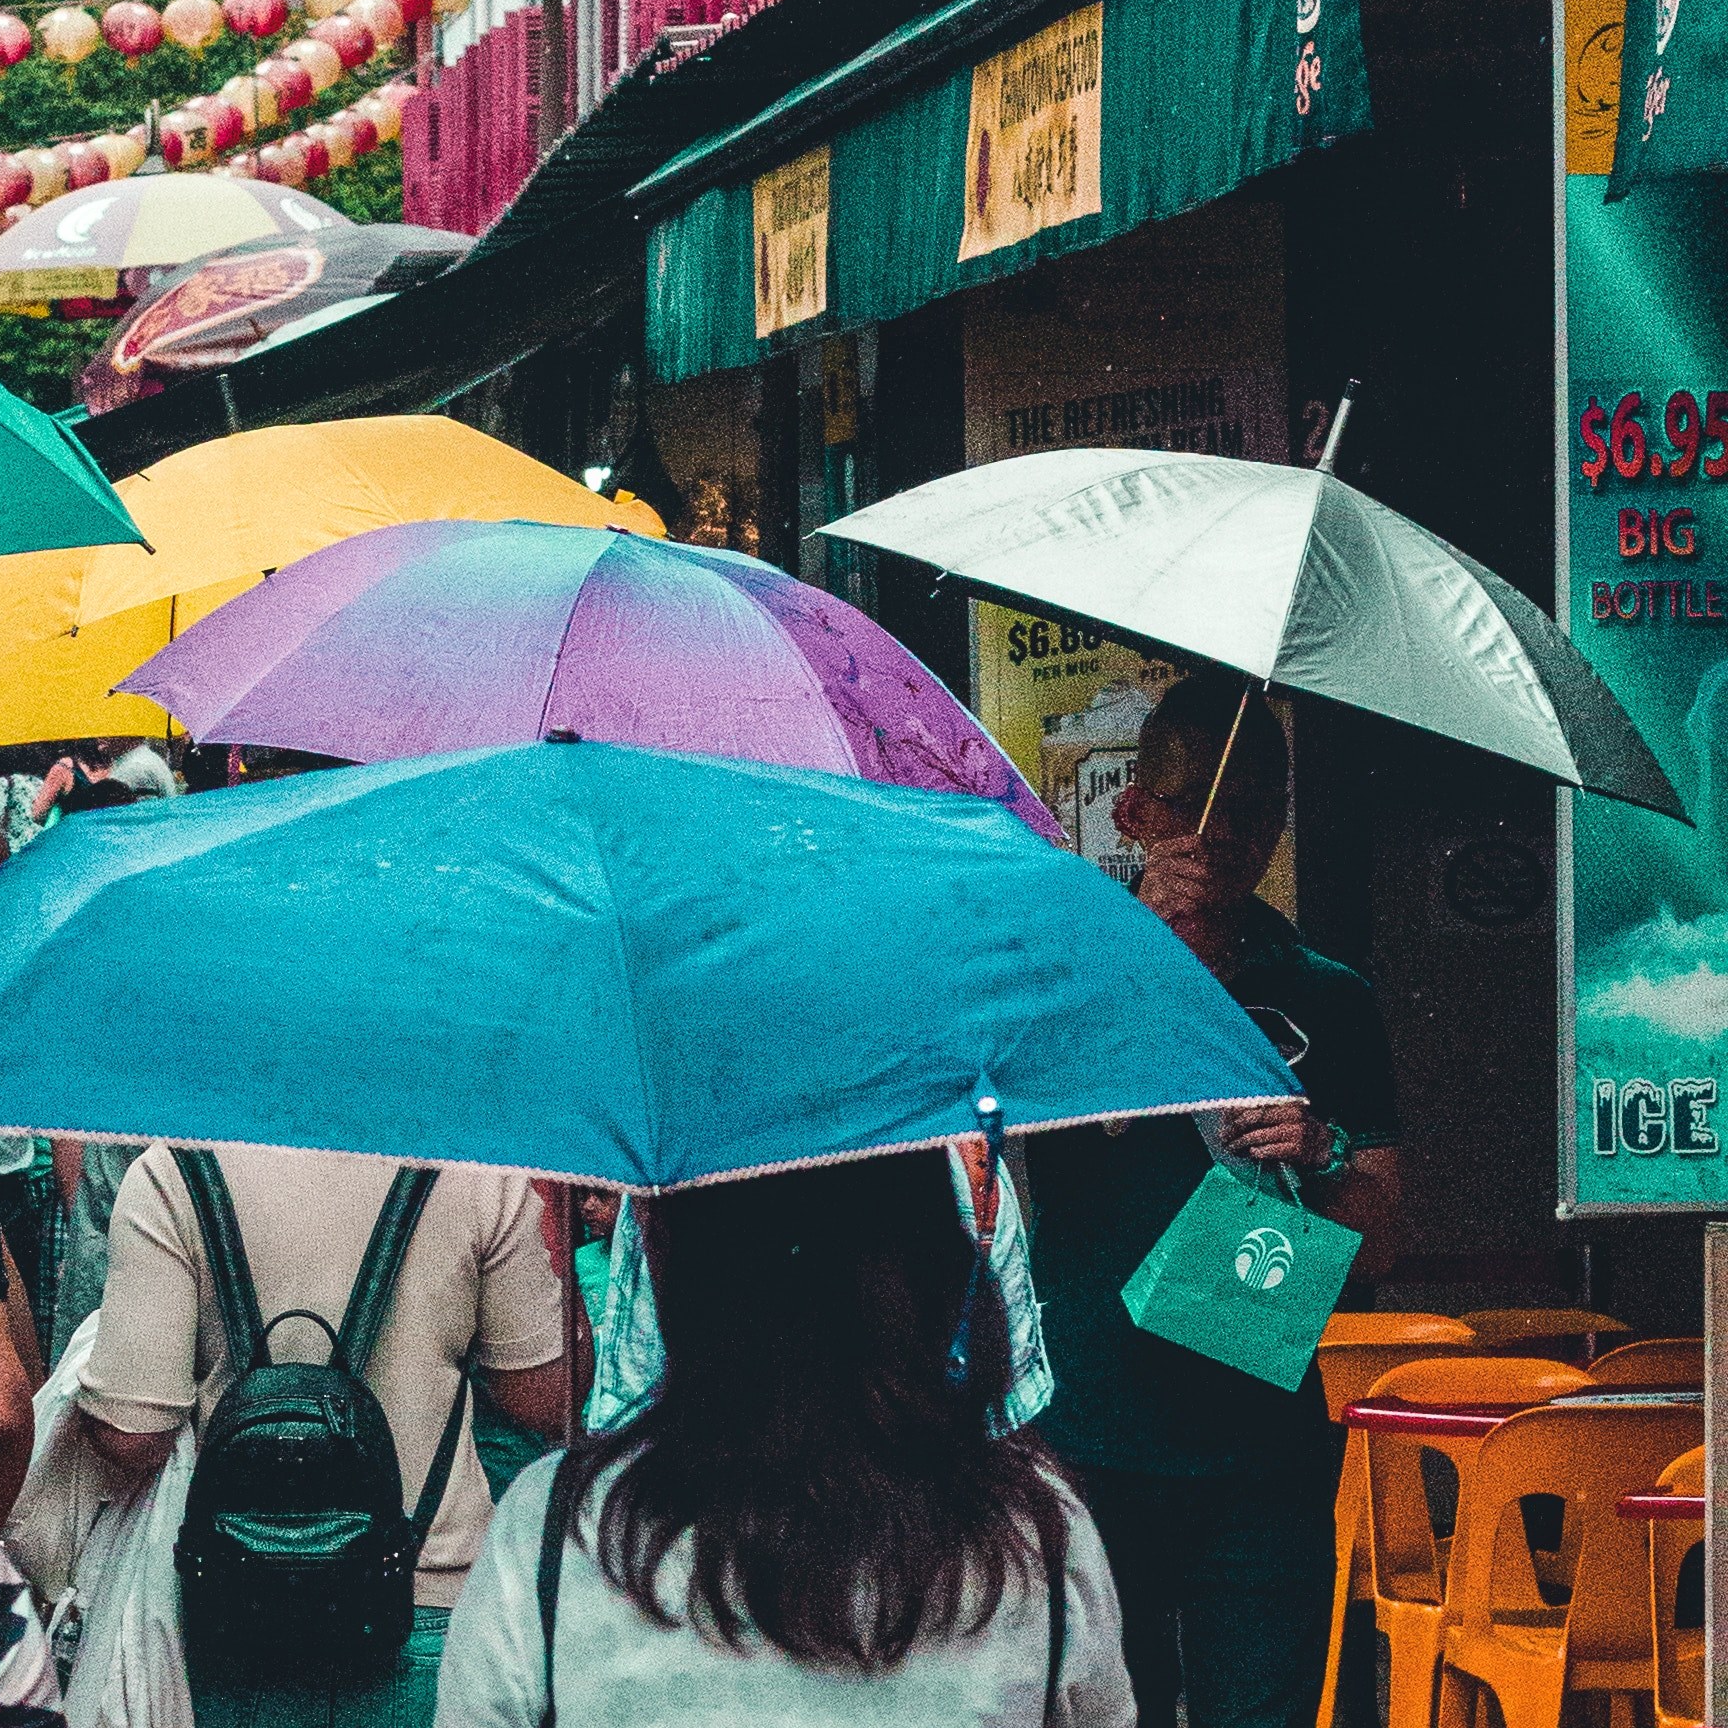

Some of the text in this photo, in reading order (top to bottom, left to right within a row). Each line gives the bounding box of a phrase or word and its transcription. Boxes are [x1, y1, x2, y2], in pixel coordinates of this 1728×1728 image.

[1004, 377, 1224, 449] THE REFRESHING
[1579, 391, 1728, 487] $6.95
[1618, 507, 1696, 557] BIG
[1591, 581, 1723, 620] BOTTLE
[1592, 1077, 1719, 1156] ICE
